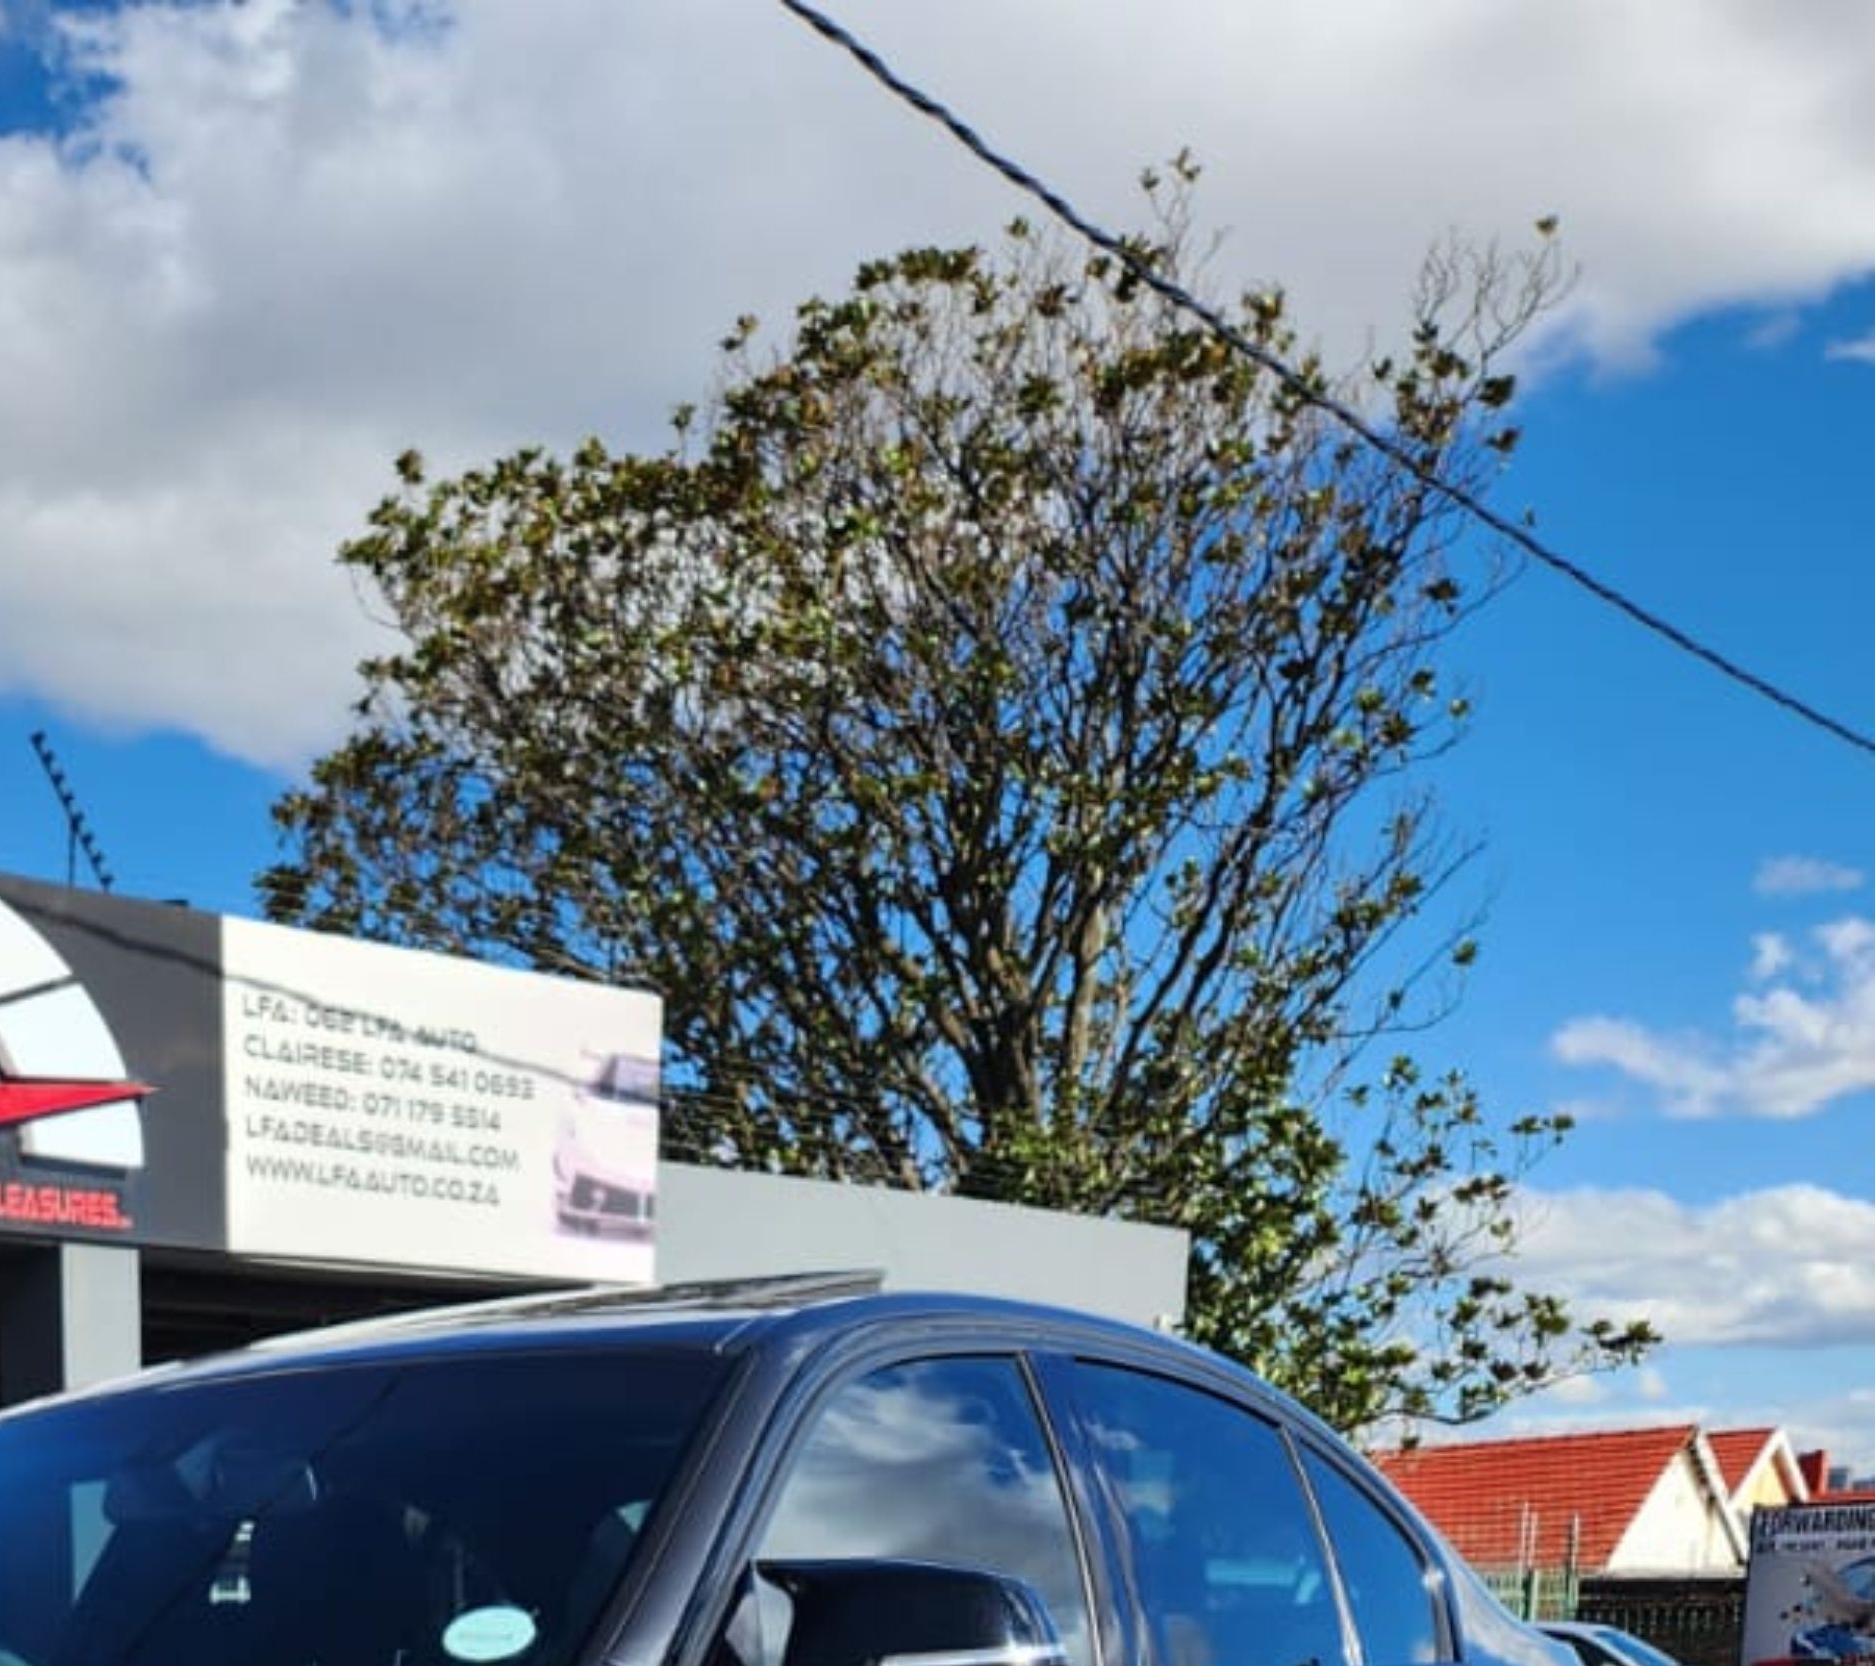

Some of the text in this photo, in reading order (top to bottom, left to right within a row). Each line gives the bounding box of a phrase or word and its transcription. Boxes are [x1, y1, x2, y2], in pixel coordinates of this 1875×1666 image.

[241, 994, 298, 1025] LFA:
[380, 1055, 424, 1083] 074
[244, 1074, 358, 1113] NAWEED:
[362, 1092, 401, 1117] 071
[246, 1153, 502, 1207] WWW.LFAAUTO.CO.ZA
